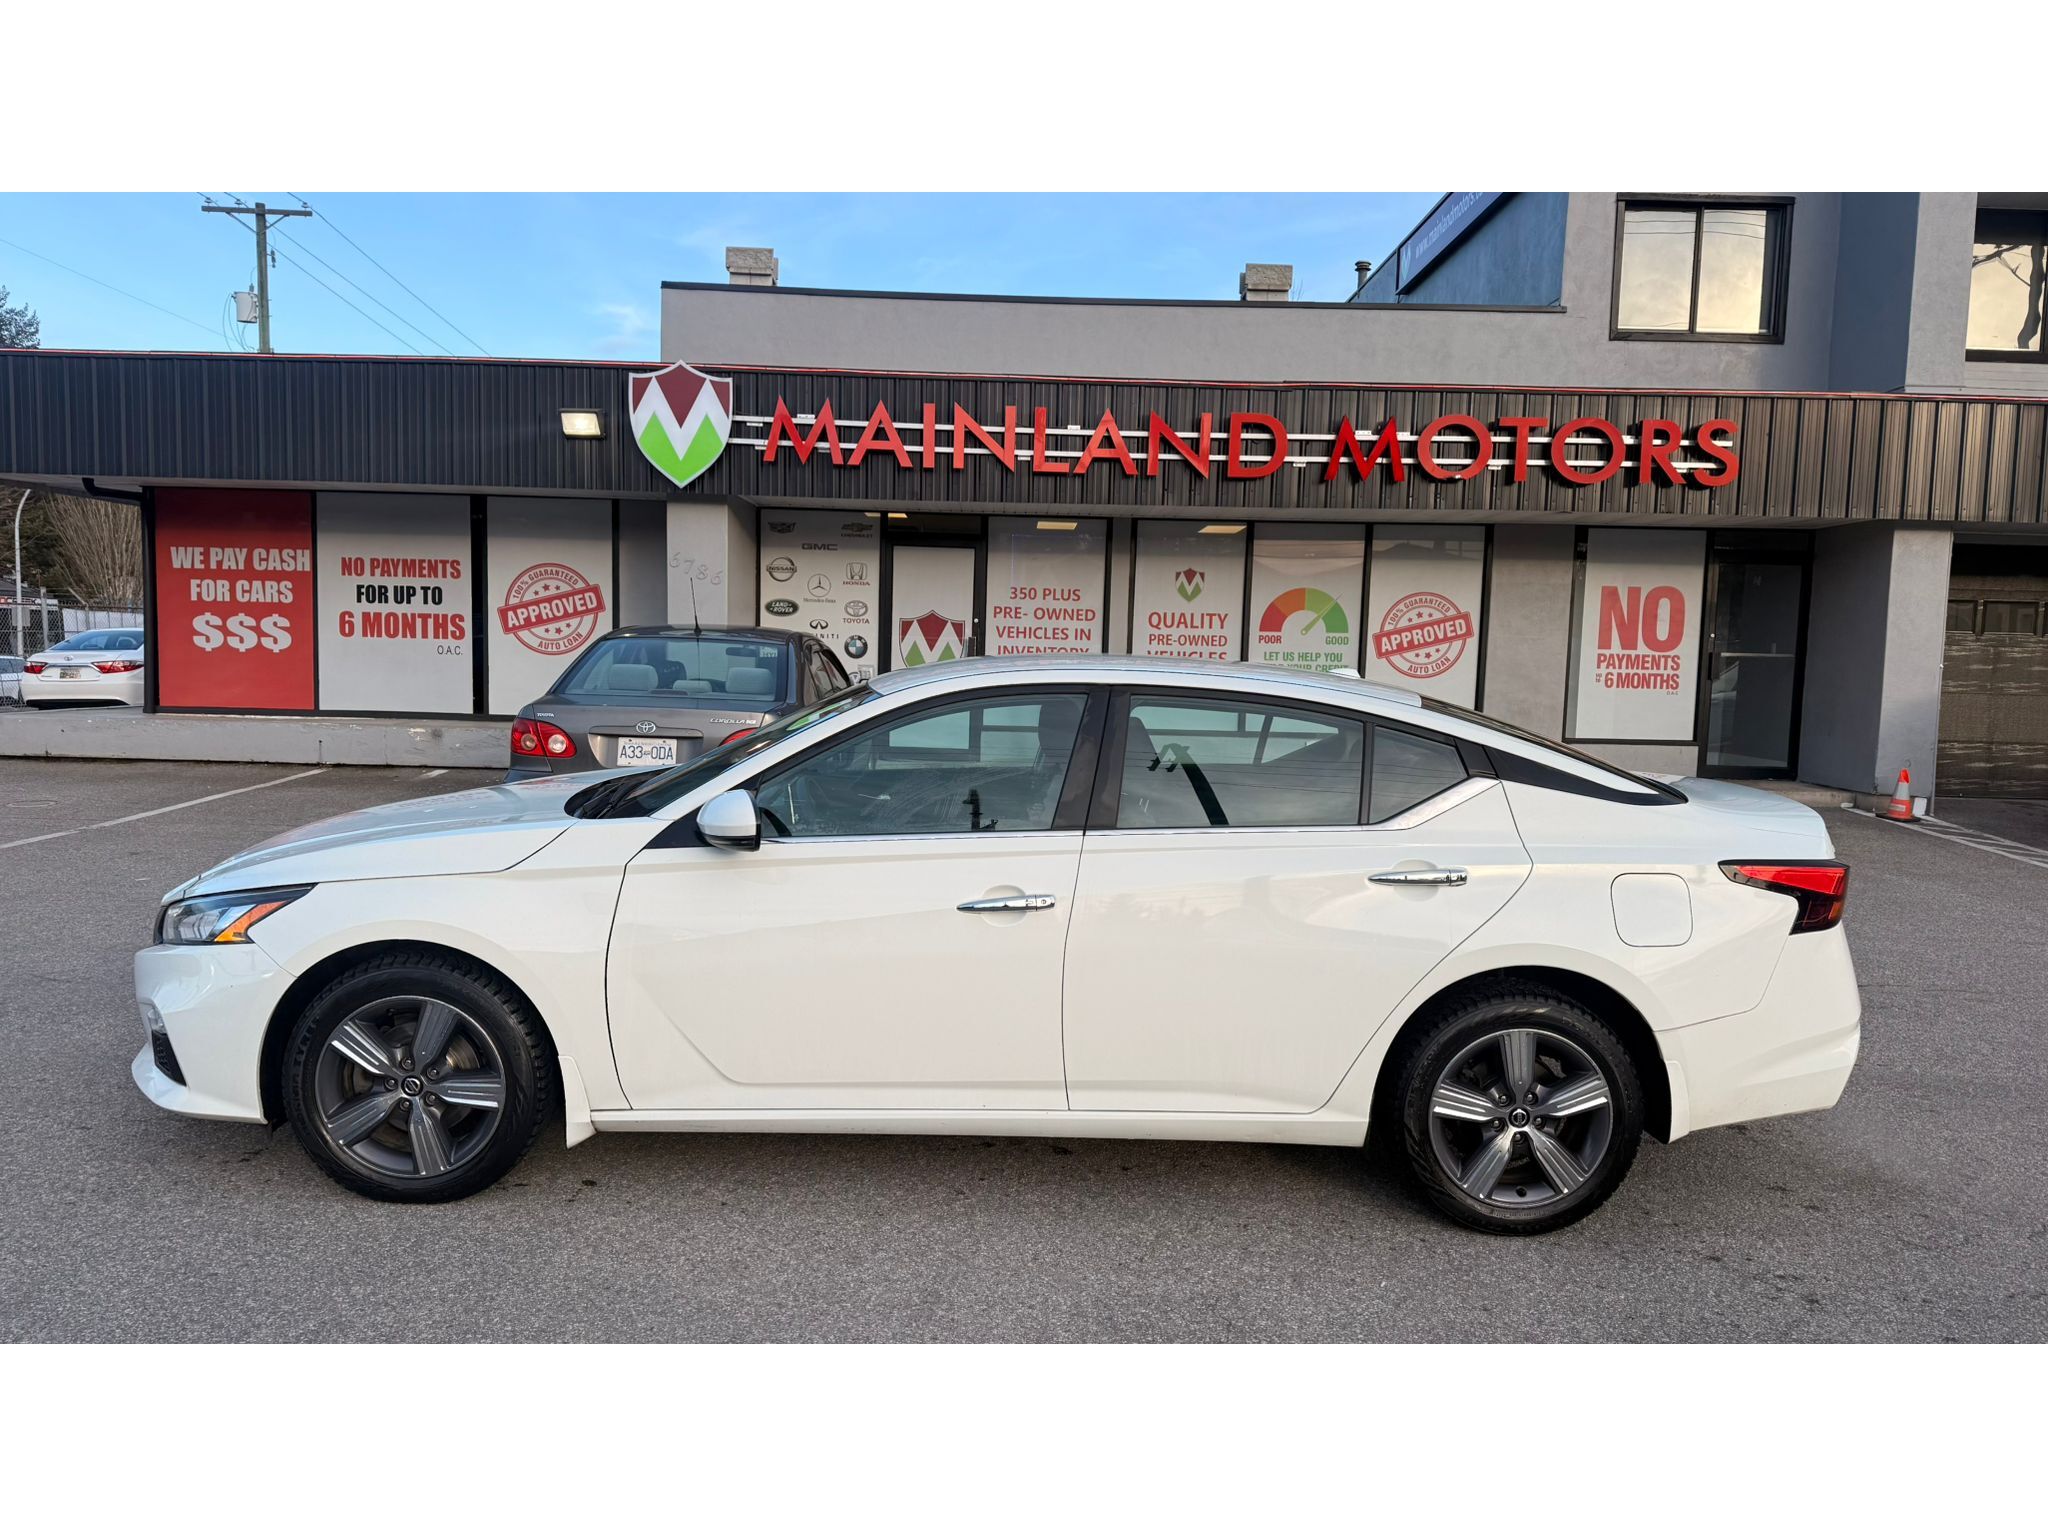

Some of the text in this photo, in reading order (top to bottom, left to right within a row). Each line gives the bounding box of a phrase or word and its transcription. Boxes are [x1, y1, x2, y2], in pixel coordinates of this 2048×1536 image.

[762, 395, 1288, 480] MAINLAND
[1324, 413, 1739, 487] MOTORS
[801, 543, 838, 551] GMC
[170, 546, 311, 571] WE PAY CASH
[341, 557, 461, 579] NO PAYMENTS
[190, 579, 293, 604] FOR CARS
[512, 568, 580, 599] 100% GUARANTEED
[356, 584, 443, 606] FOR UP TO
[1009, 587, 1081, 602] 350 PLUS
[507, 591, 598, 628] APPROVED
[993, 606, 1096, 621] PRE- OWNED
[1388, 597, 1451, 626] 100% GUARANTEED
[1597, 585, 1686, 653] NO
[339, 610, 466, 641] 6 MONTHS
[1148, 611, 1229, 630] QUALITY
[192, 612, 292, 653] $$$
[537, 631, 584, 650] AUTO LOAN
[995, 626, 1092, 641] VEHICLES IN
[1148, 634, 1228, 647] PRE-OWNED
[1258, 635, 1282, 644] POOR
[1325, 636, 1349, 645] GOOD
[1381, 619, 1467, 653] APPROVED
[436, 645, 463, 655] O.A.C.
[1264, 651, 1343, 662] LET US HELP YOU
[1407, 656, 1452, 673] AUTO LOAN
[1596, 653, 1680, 671] PAYMENTS
[1604, 672, 1614, 689] 6
[1616, 672, 1680, 690] MONTHS
